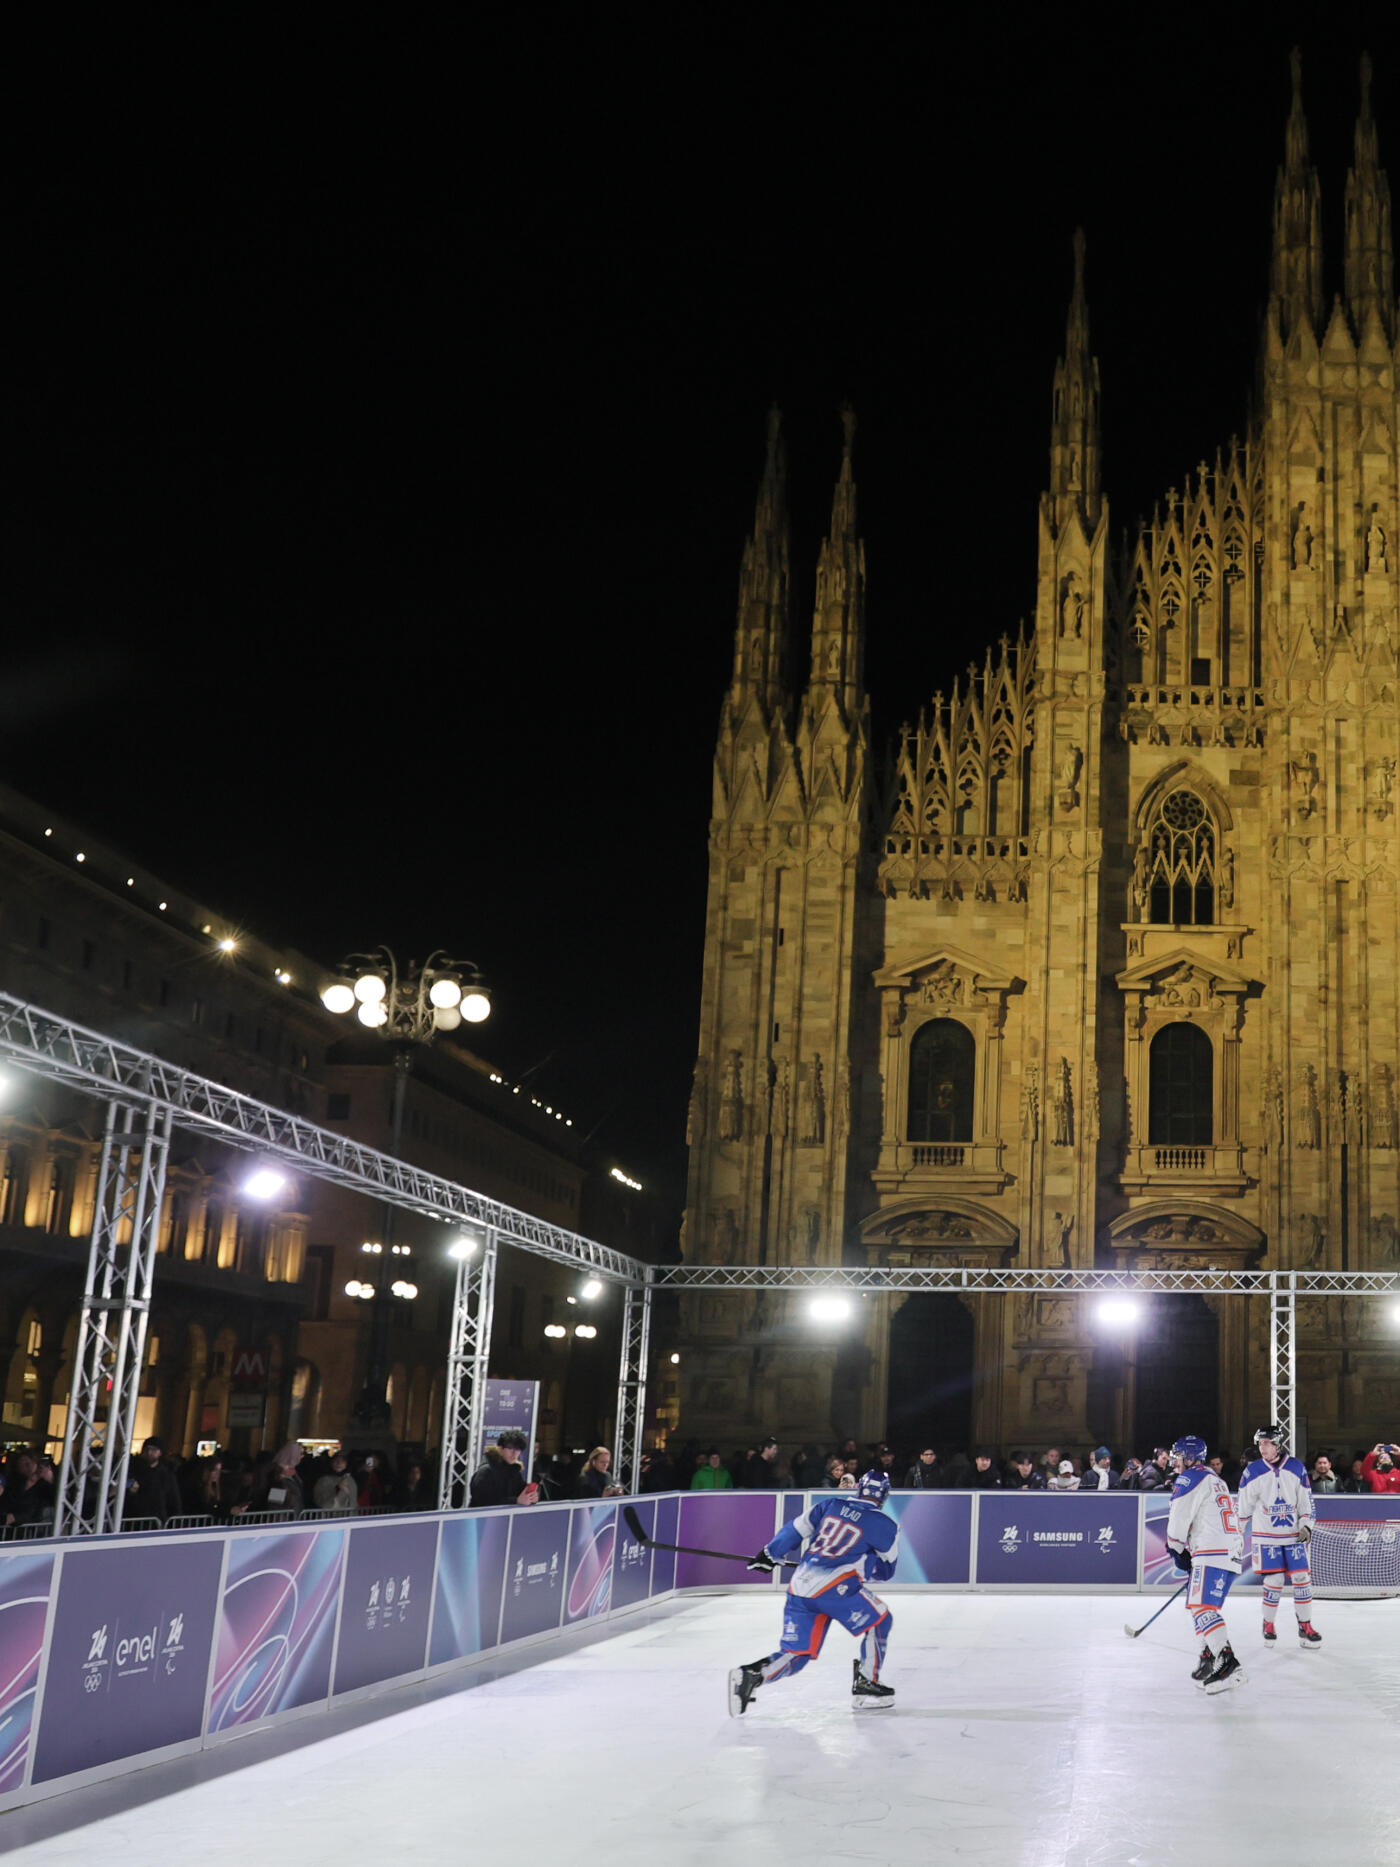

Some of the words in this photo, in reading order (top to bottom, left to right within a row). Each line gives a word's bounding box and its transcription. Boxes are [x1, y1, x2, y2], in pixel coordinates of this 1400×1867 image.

[839, 1505, 862, 1522] VLAD
[808, 1515, 864, 1559] 80
[1033, 1532, 1083, 1541] SAMSUNG
[116, 1626, 157, 1666] enel
